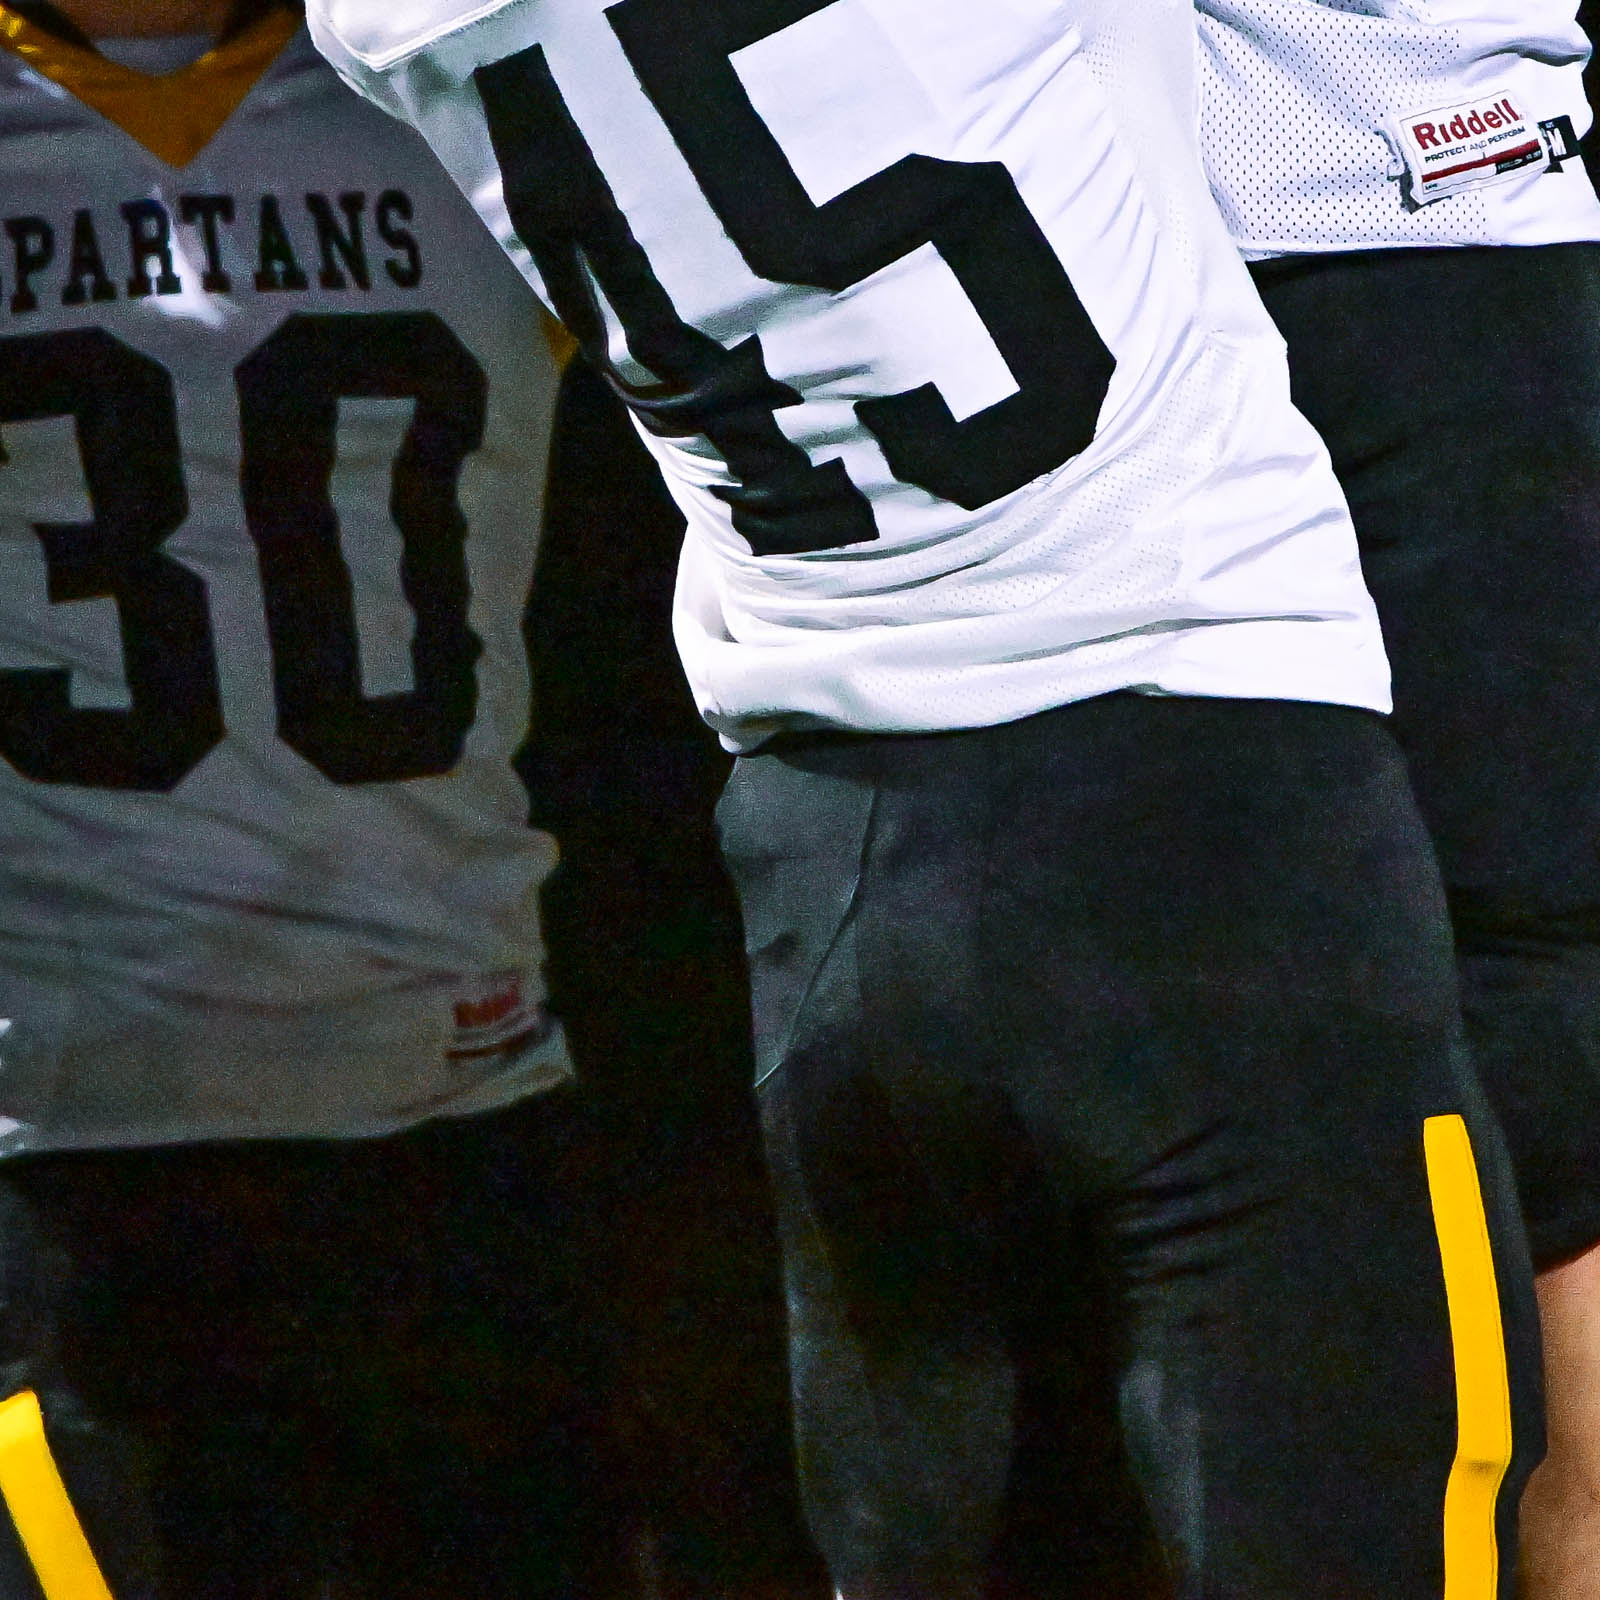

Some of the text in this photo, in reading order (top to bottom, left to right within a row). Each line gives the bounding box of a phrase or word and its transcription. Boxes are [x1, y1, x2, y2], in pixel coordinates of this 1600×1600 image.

[1412, 98, 1521, 151] Riddell
[1424, 144, 1468, 164] PROTECT
[1488, 125, 1527, 146] PERFORM
